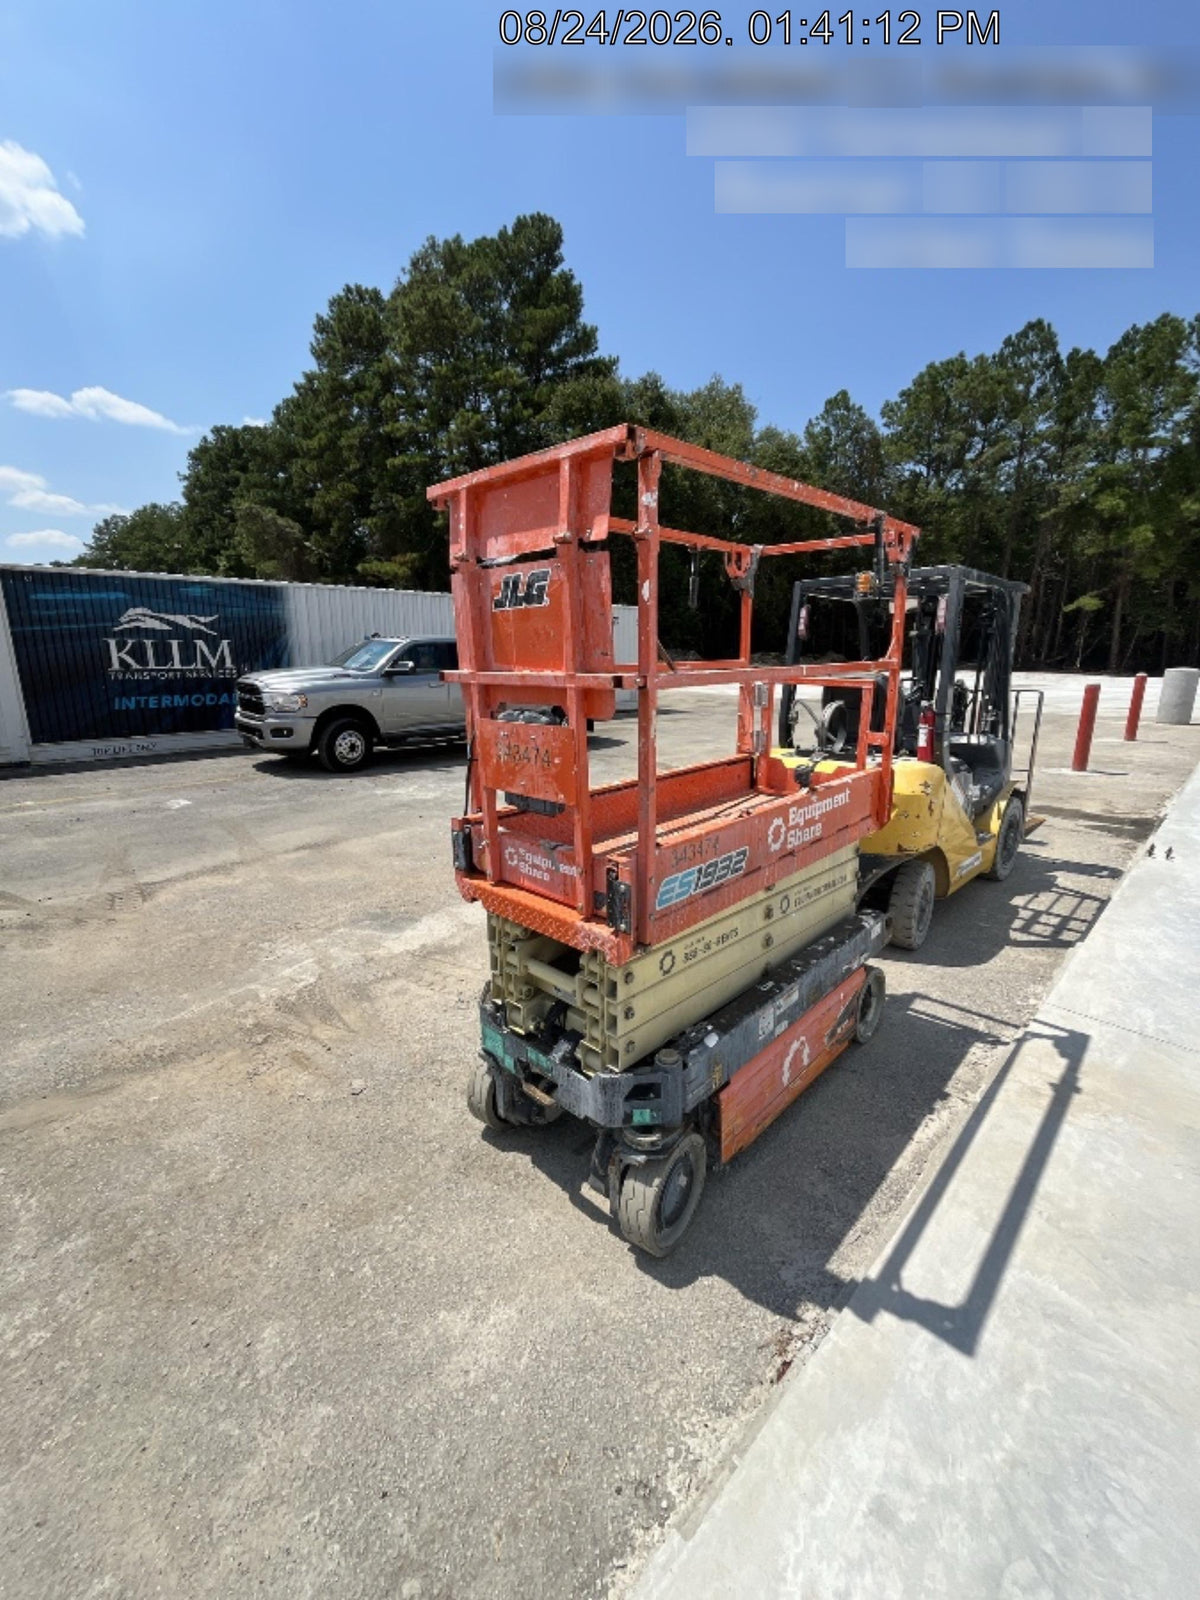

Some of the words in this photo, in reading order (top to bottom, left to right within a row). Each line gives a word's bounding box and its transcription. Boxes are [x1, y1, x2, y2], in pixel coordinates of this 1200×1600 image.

[492, 568, 551, 612] JLG
[103, 638, 235, 671] KLLM
[788, 787, 851, 827] Equipment
[787, 822, 822, 850] Share
[656, 846, 749, 911] ES1932
